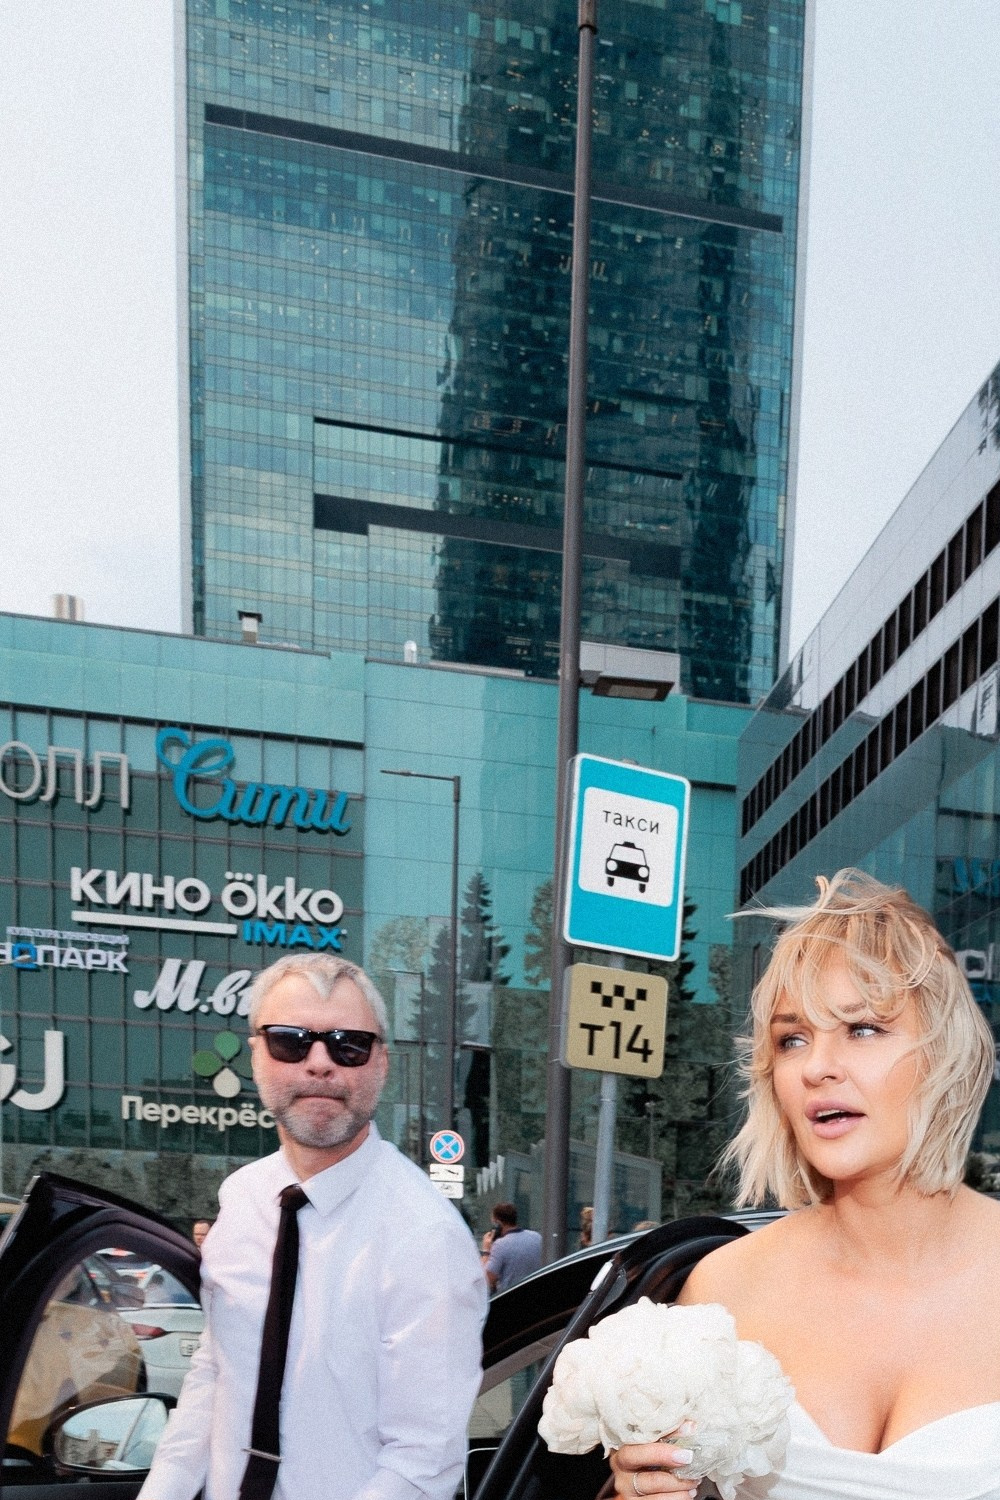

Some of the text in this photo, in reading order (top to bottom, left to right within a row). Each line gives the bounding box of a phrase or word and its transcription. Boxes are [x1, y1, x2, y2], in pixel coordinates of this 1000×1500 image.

[155, 728, 352, 832] Сити
[70, 867, 211, 912] КИНО
[242, 919, 343, 950] IMAX
[579, 1020, 654, 1064] Т14
[121, 1094, 277, 1132] Перекрёс
